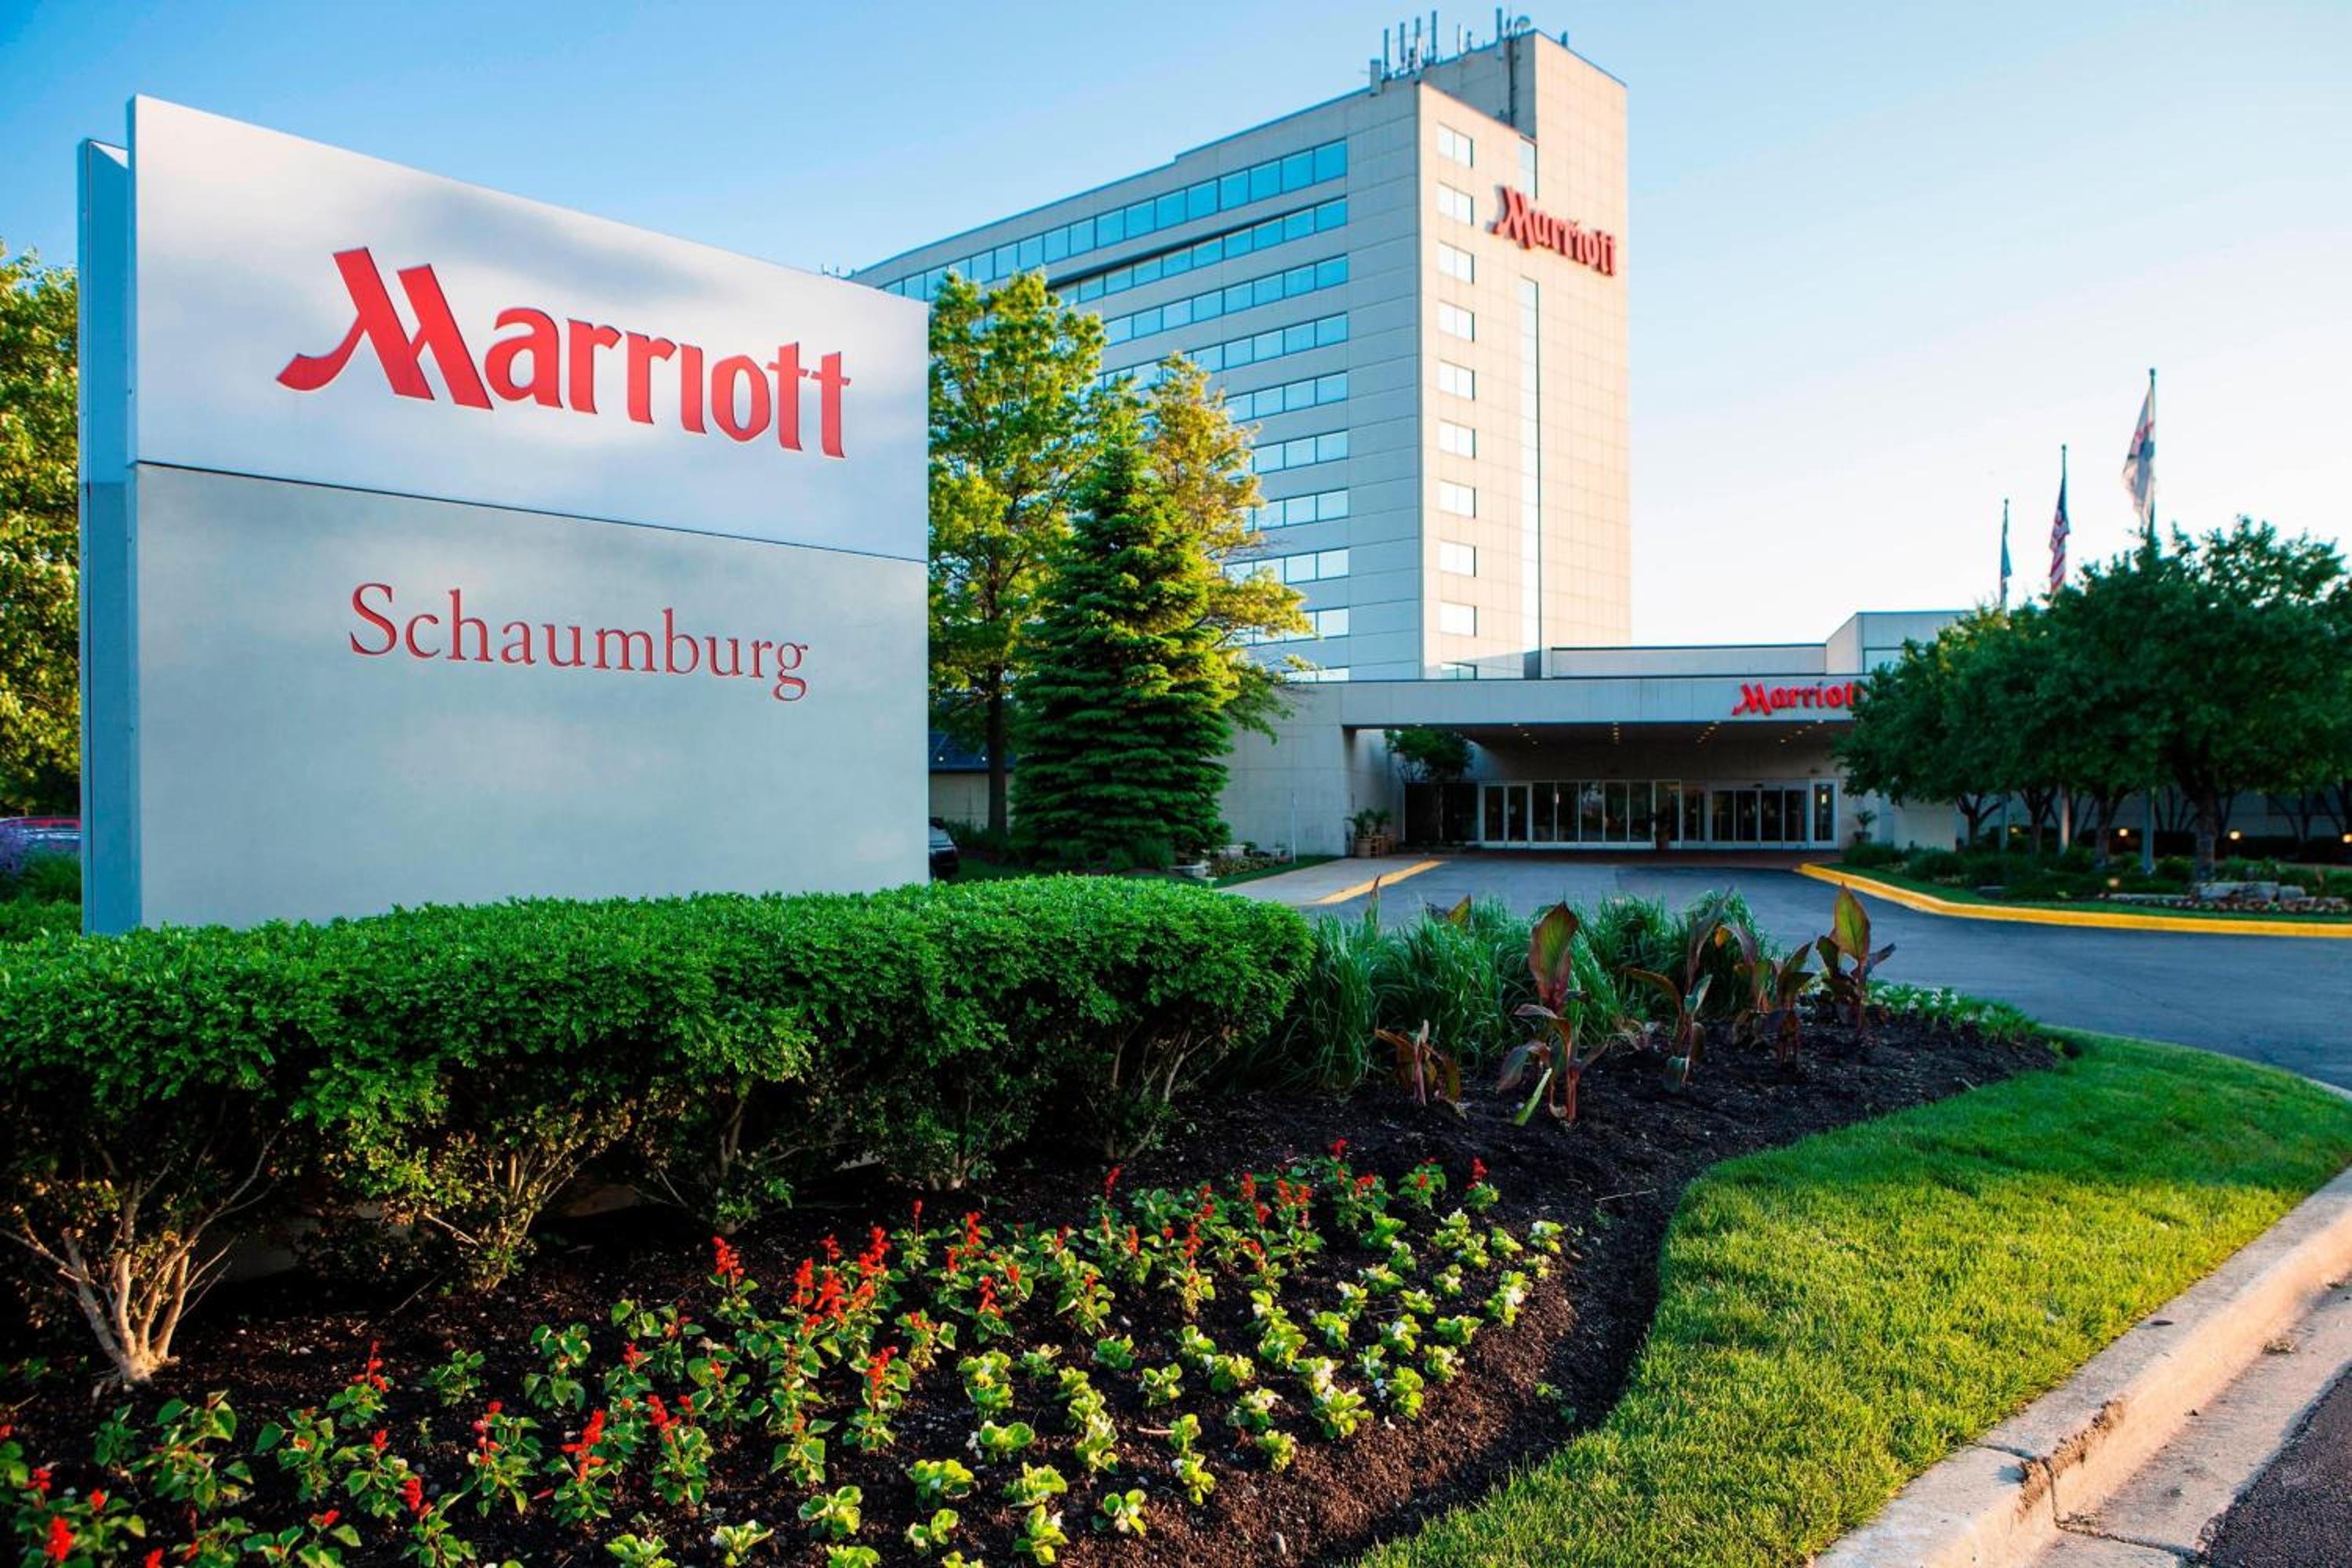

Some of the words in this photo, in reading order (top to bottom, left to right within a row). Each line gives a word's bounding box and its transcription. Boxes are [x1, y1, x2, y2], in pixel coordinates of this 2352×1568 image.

[1486, 185, 1616, 276] Marriott
[277, 246, 851, 459] Marriott
[350, 583, 809, 701] Schaumburg
[1732, 681, 1863, 716] Marriot
